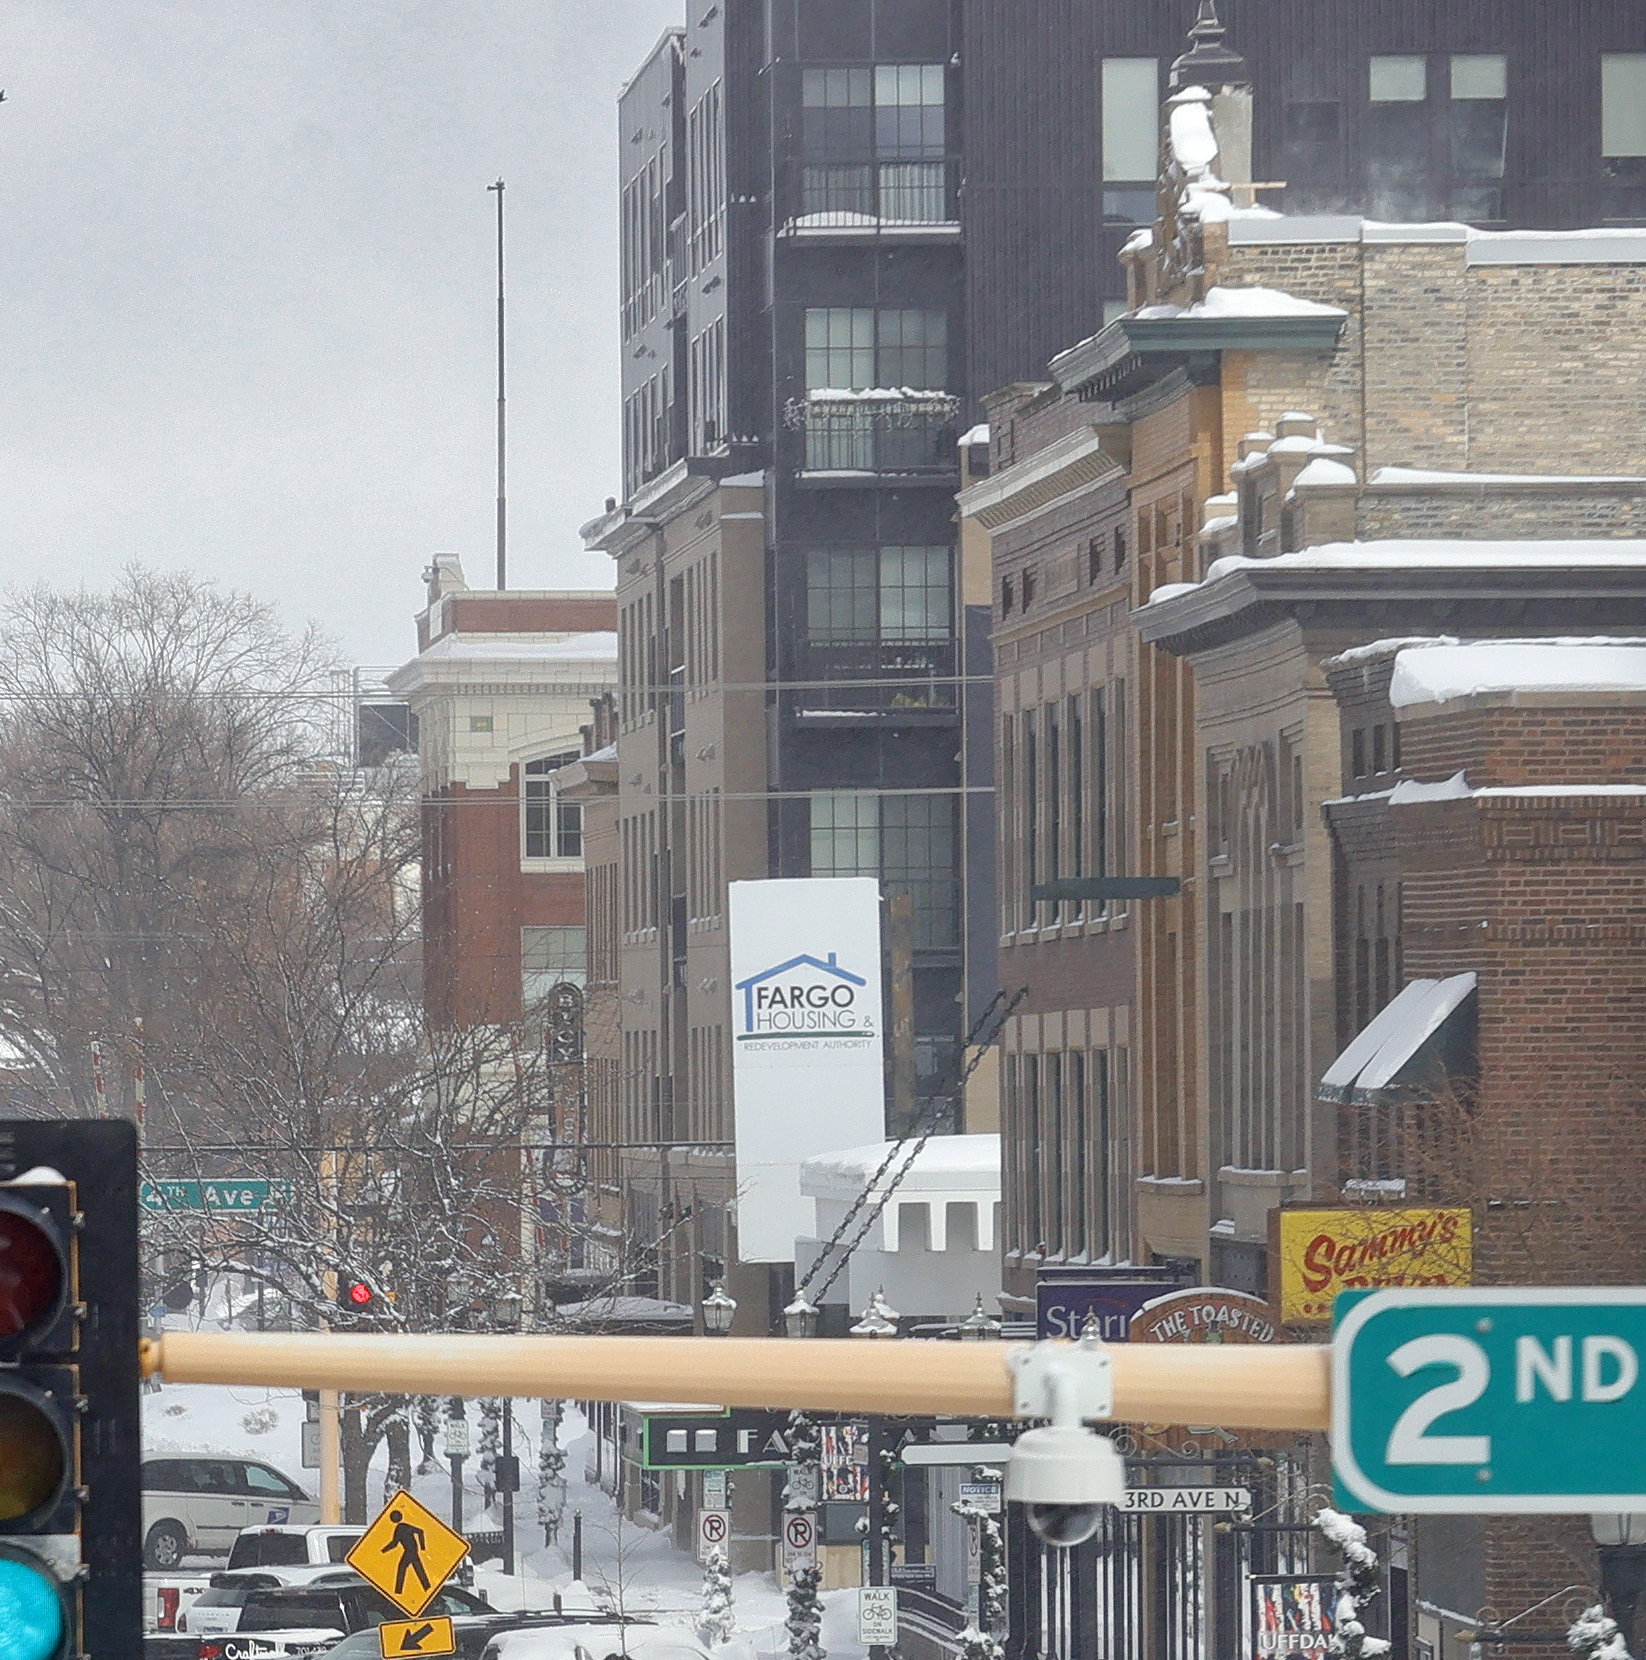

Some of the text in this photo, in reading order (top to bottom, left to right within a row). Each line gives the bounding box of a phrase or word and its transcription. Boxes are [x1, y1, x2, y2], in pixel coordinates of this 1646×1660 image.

[757, 984, 855, 1010] FARGO
[757, 1009, 874, 1030] HOUSING &
[743, 1039, 872, 1051] REDEVELOPMENT AUTHORITY
[205, 1185, 254, 1206] Ave
[1302, 1212, 1459, 1293] Sammy's
[1150, 1304, 1276, 1343] THE TOASTED
[1384, 1332, 1640, 1466] 2ND
[1124, 1491, 1240, 1508] 3RD AVE N
[864, 1592, 890, 1601] WALK
